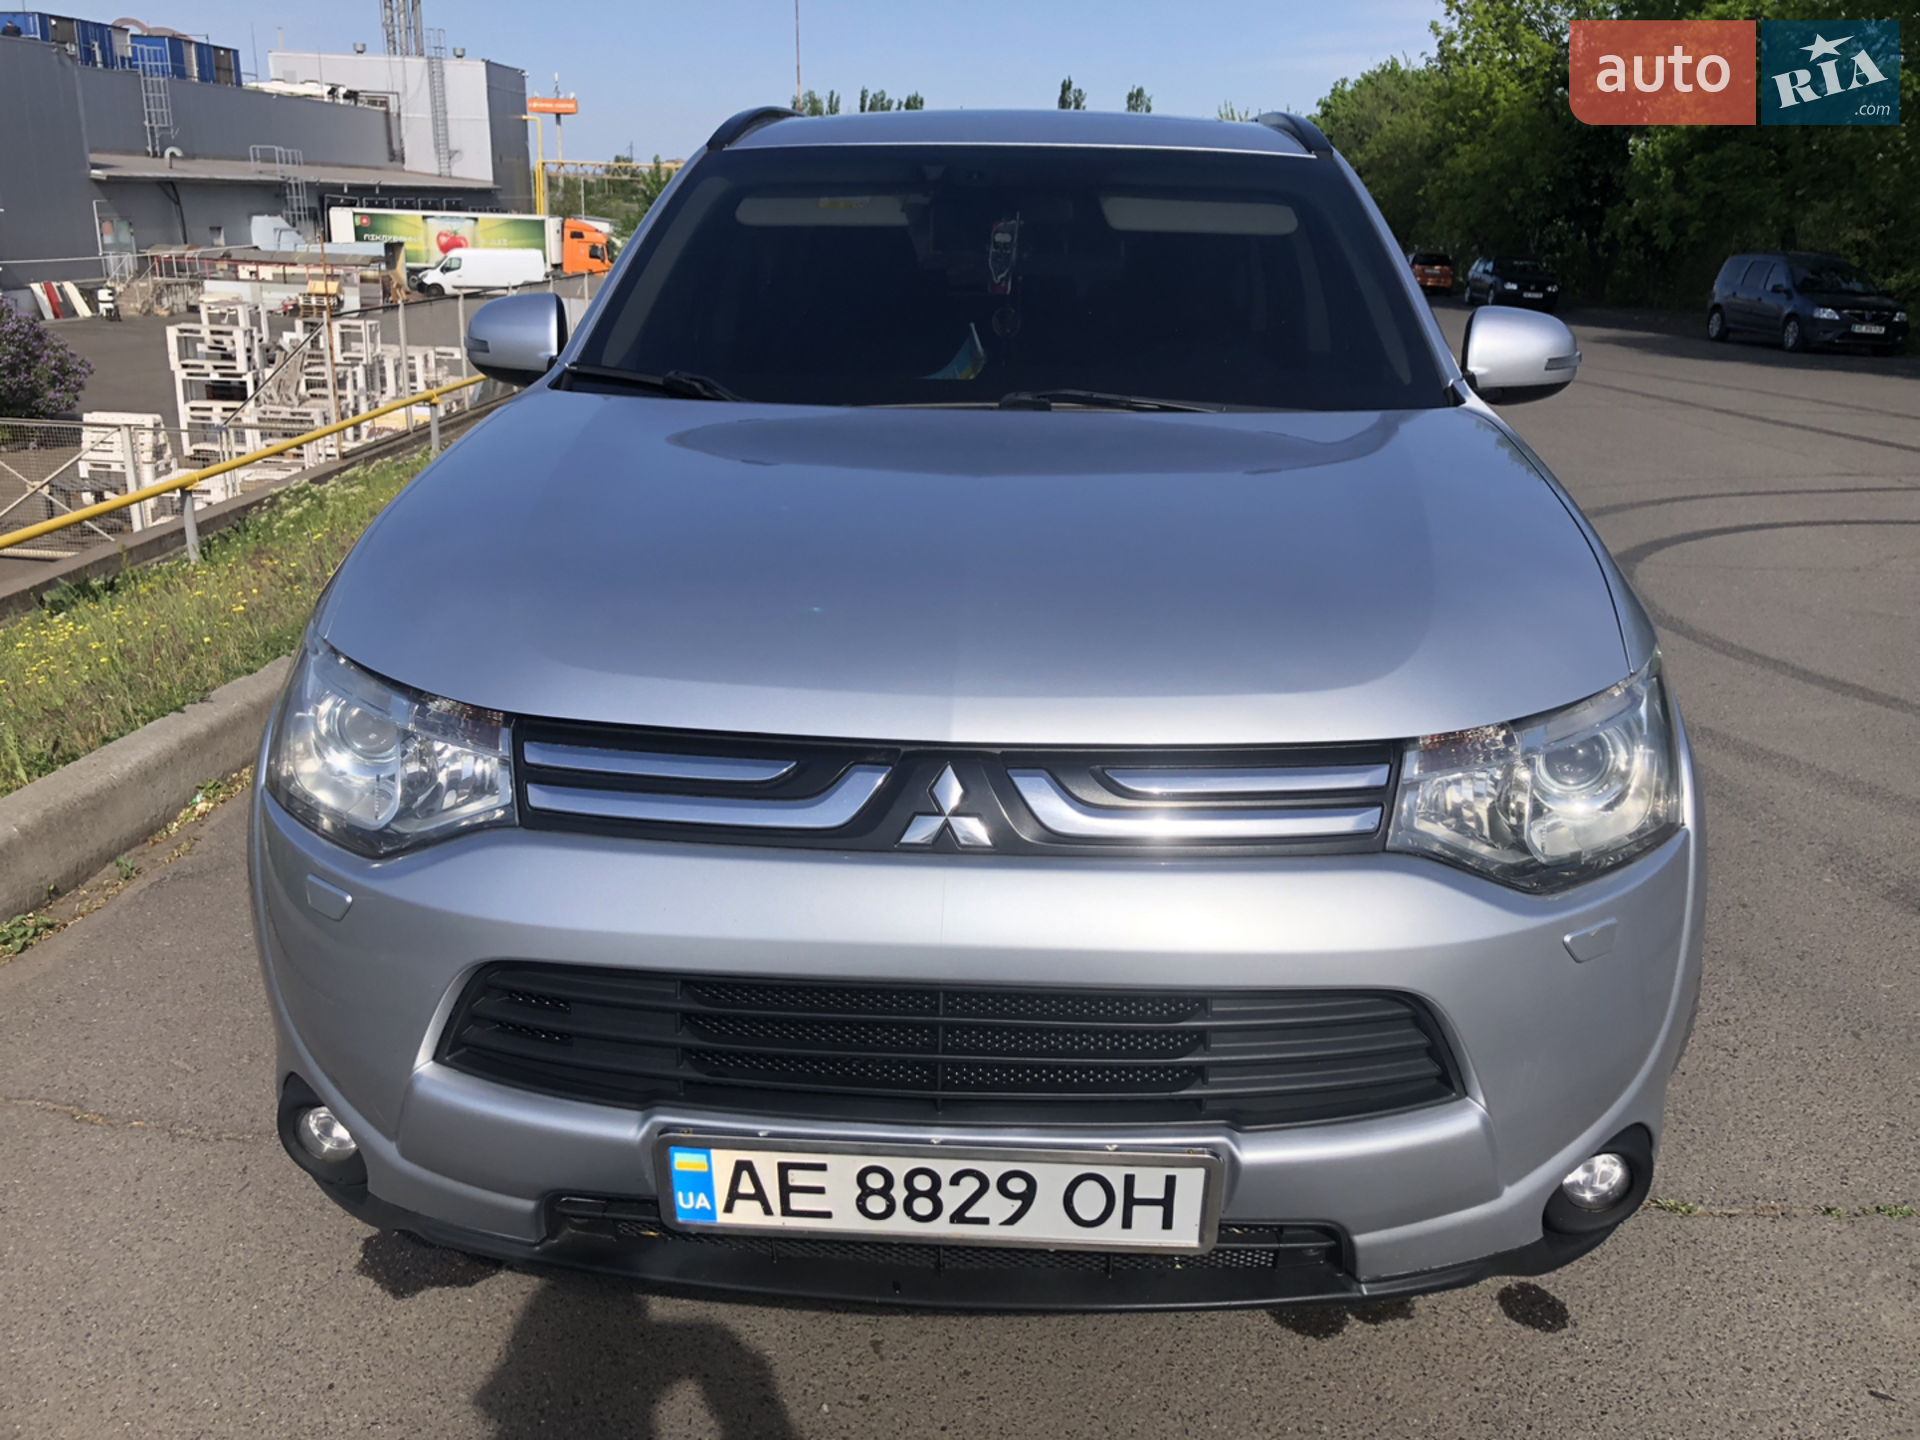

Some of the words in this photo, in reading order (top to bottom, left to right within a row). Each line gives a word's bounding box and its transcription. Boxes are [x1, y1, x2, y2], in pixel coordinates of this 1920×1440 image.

[677, 1191, 712, 1211] UA
[722, 1159, 833, 1219] AE
[855, 1165, 1040, 1226] 8829
[1062, 1172, 1178, 1230] OH
